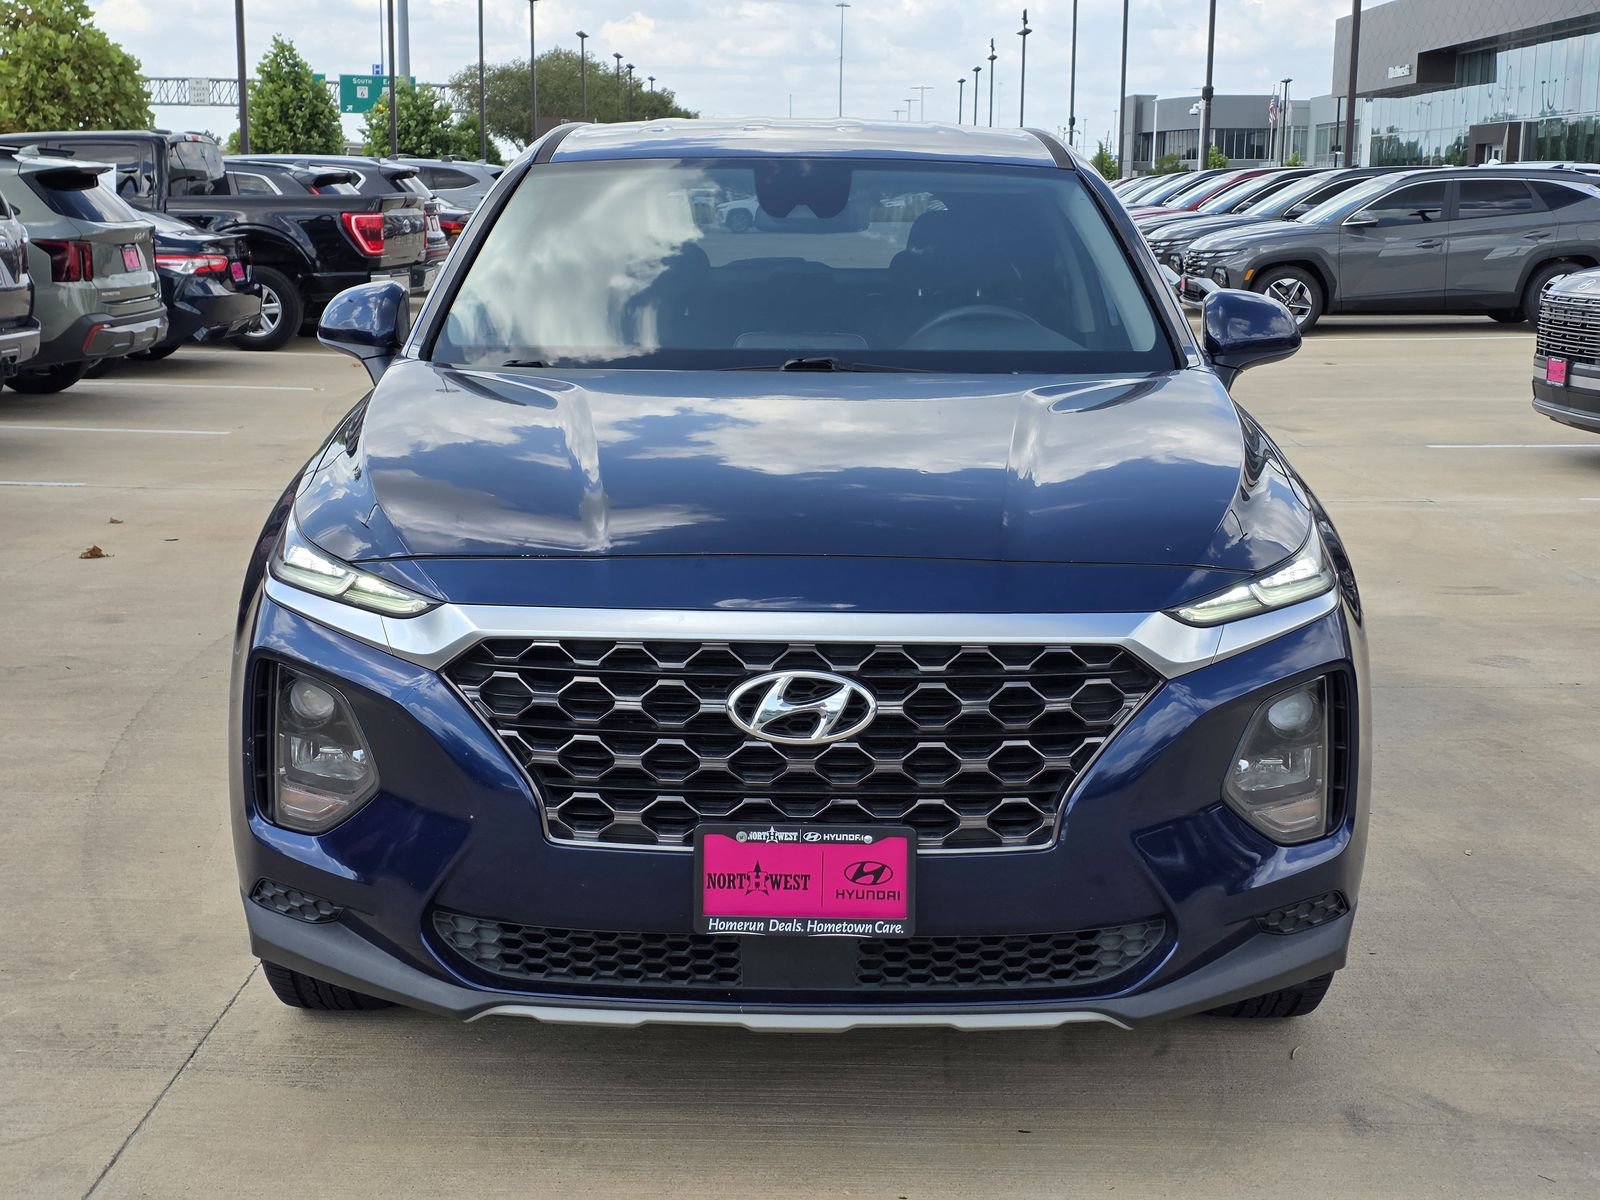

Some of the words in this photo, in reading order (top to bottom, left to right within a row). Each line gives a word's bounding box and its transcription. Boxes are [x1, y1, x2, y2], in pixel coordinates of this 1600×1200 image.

[823, 833, 865, 841] HYUNDAI
[706, 868, 811, 894] NORTHWEST
[836, 889, 900, 901] HYUNDAI
[708, 918, 764, 931] Homerun
[768, 919, 804, 932] Deals.
[806, 920, 872, 933] Hometown
[874, 921, 905, 934] Care.
